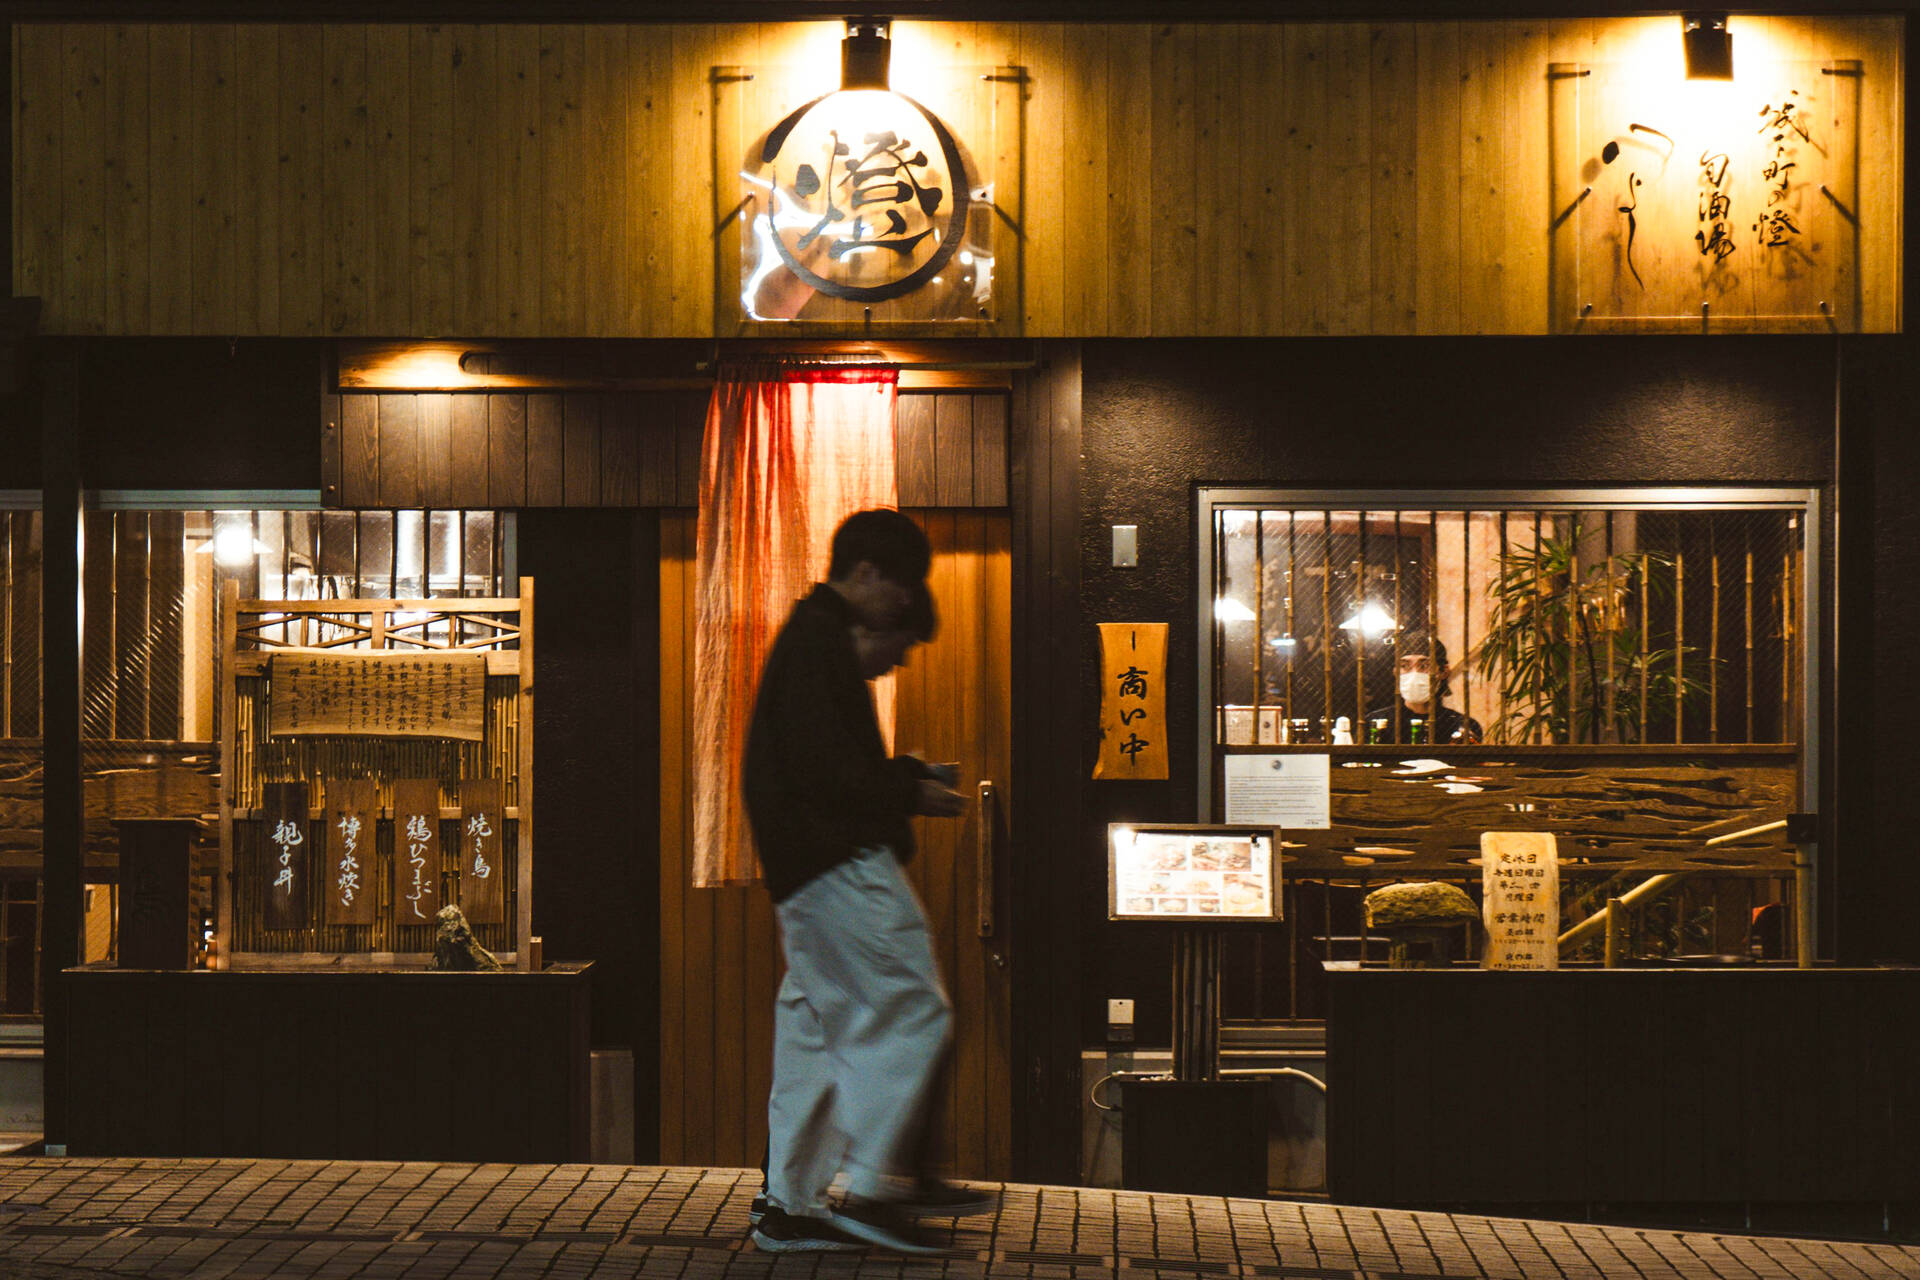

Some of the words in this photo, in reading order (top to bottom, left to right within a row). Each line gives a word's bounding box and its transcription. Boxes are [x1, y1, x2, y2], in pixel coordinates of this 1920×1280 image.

[1117, 666, 1149, 766] 商い中
[271, 818, 304, 896] 親子丼
[337, 815, 362, 907] 博多水炊き
[406, 814, 433, 919] 鶏ひつまぶし
[467, 812, 493, 879] 焼き鳥
[1500, 853, 1537, 864] 定休日
